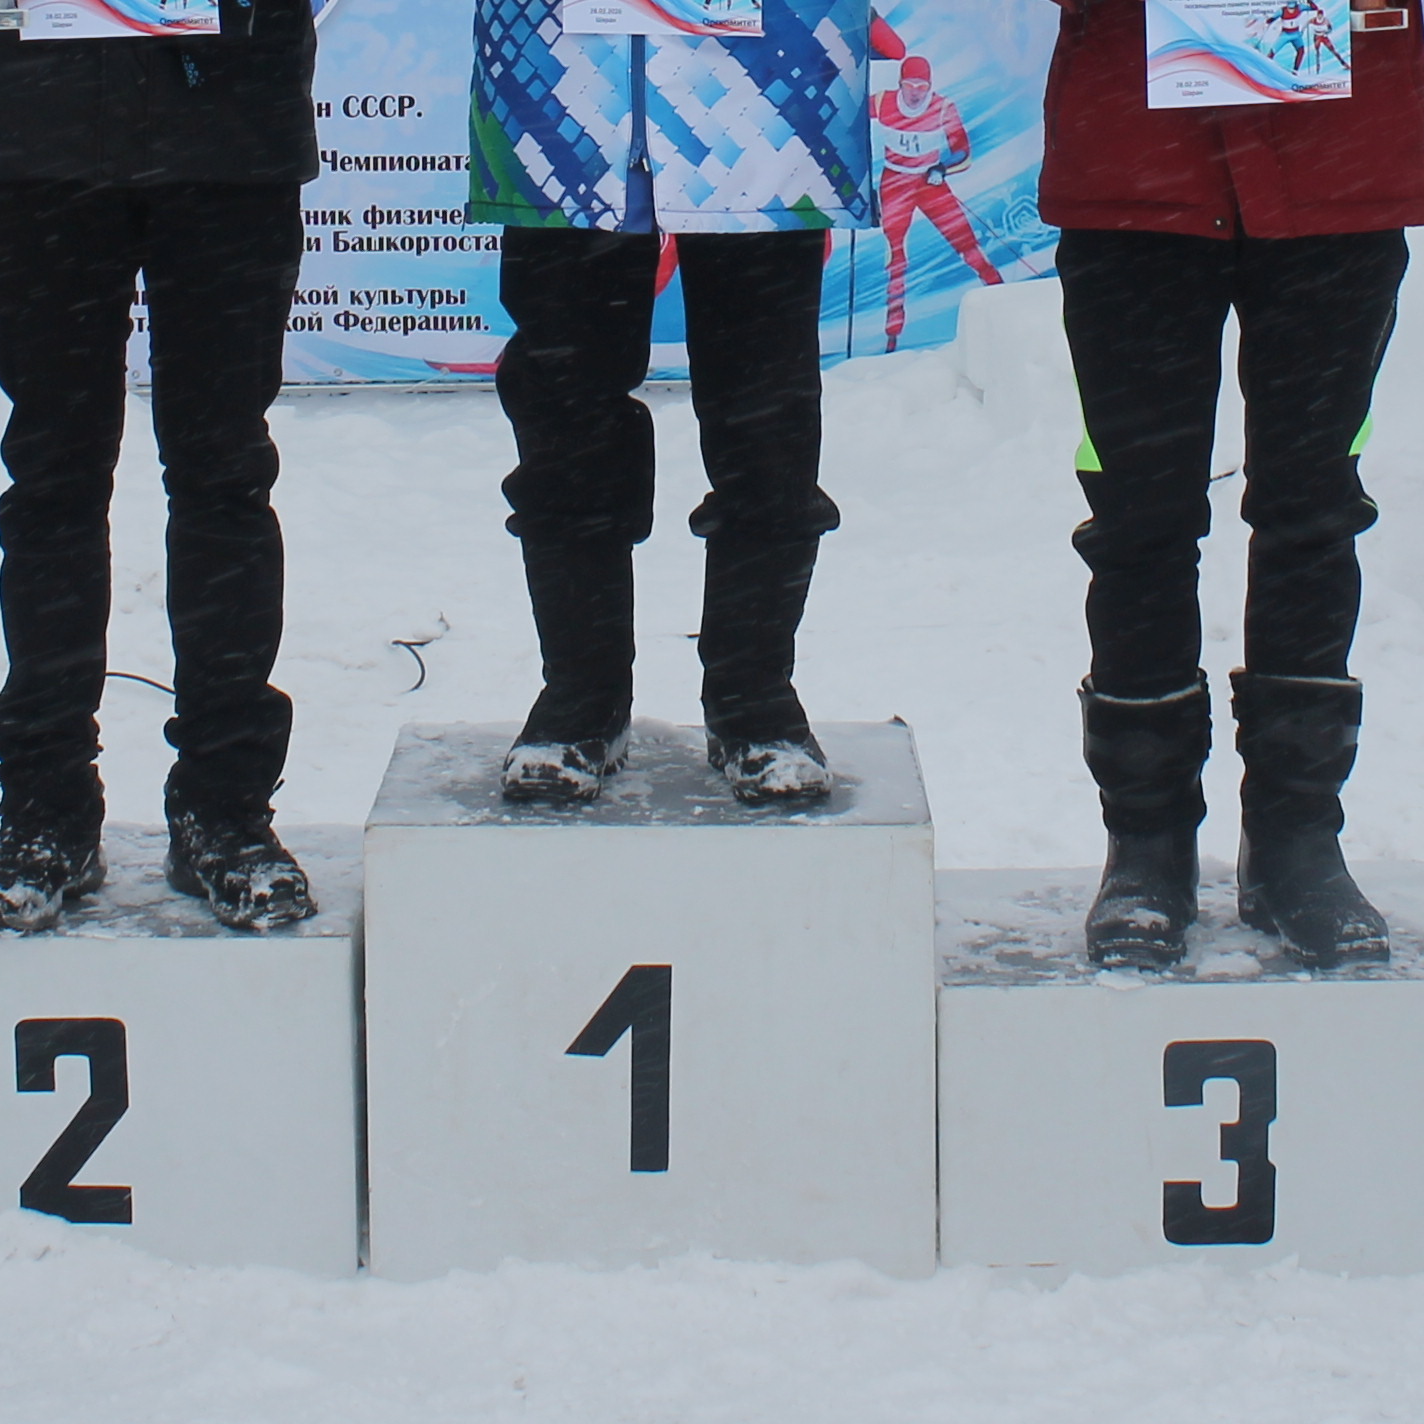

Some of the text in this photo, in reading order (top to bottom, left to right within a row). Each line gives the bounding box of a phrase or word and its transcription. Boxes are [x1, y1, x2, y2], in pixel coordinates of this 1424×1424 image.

[342, 95, 423, 118] СССР.
[298, 204, 472, 229] ник физиче
[294, 285, 466, 310] кой культуры
[285, 310, 489, 336] кой Федерации.
[566, 964, 672, 1172] 1
[15, 1016, 132, 1224] 2
[1162, 1039, 1277, 1246] 3
